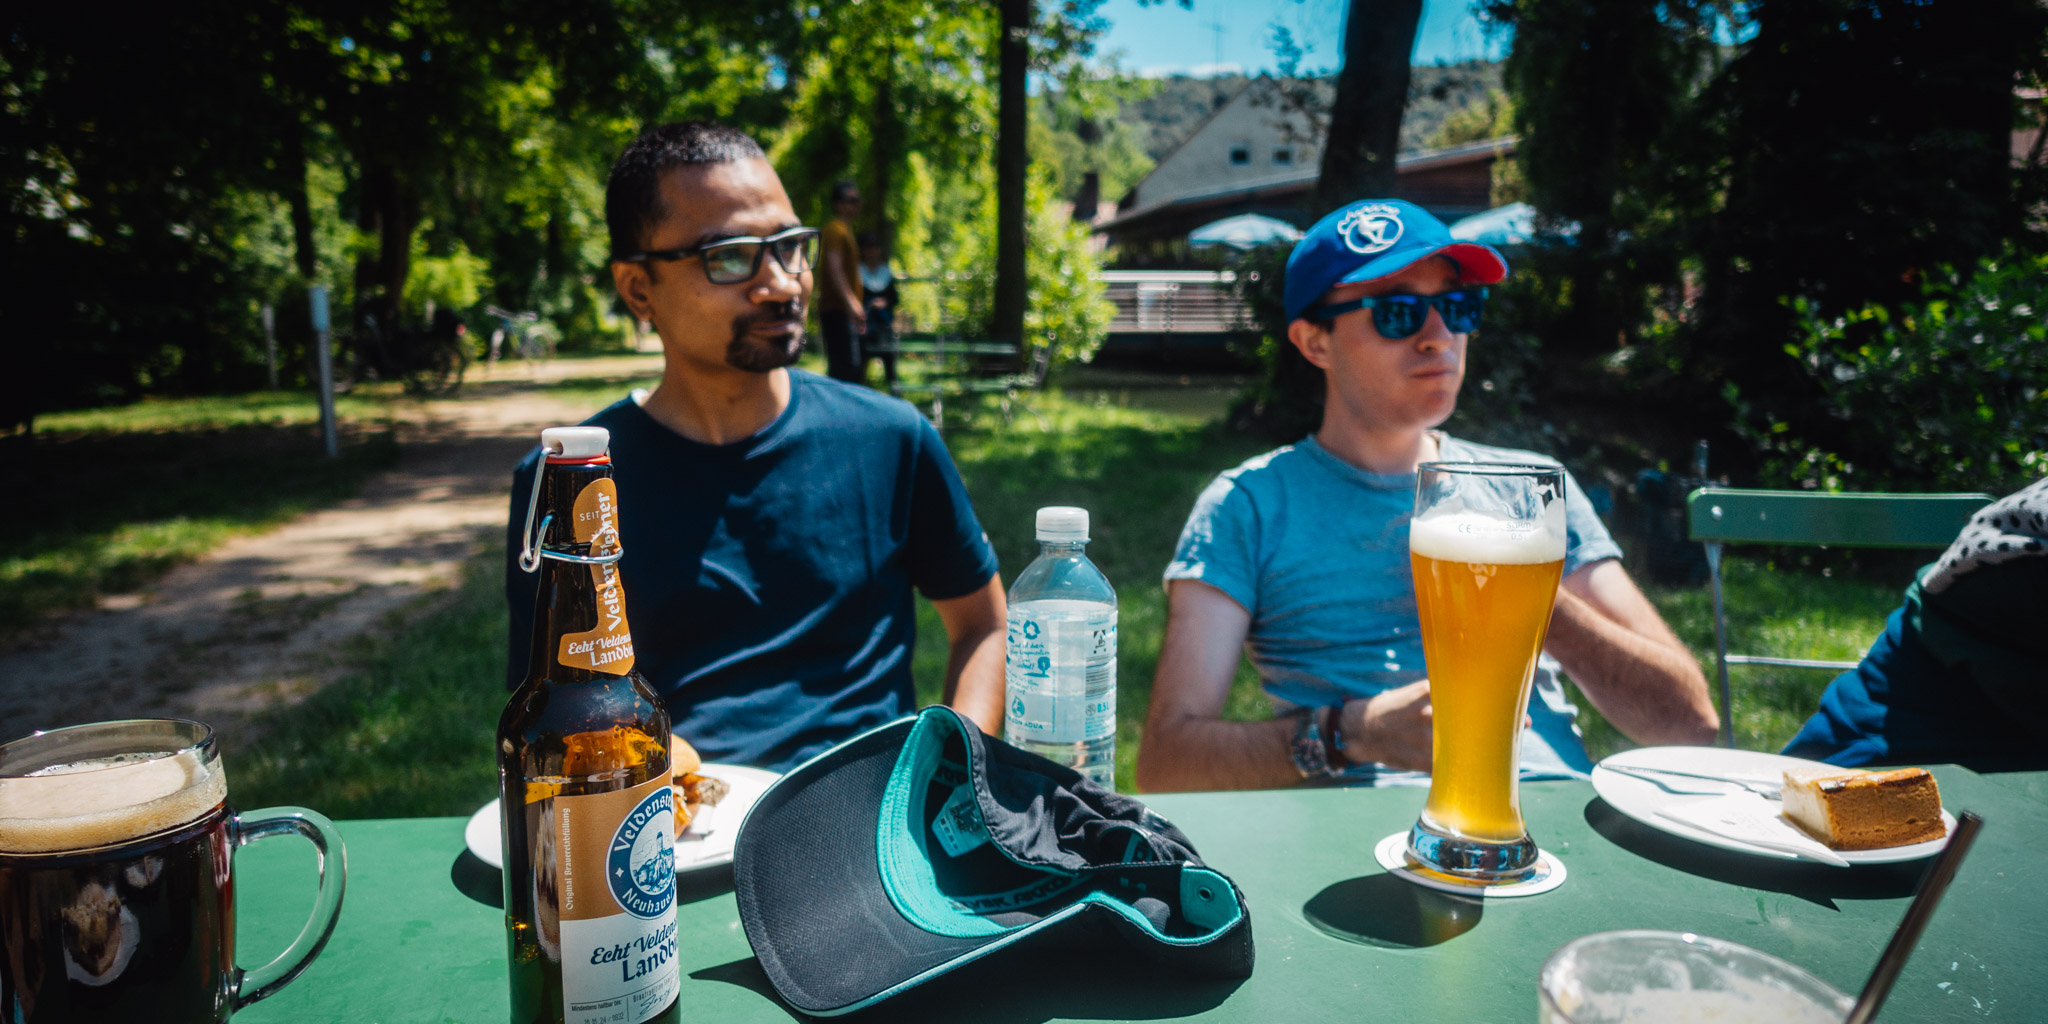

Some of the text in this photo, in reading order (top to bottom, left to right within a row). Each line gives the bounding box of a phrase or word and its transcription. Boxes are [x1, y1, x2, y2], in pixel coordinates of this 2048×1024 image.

[579, 510, 600, 521] SEIT
[568, 640, 595, 655] Echt
[565, 877, 575, 911] Original
[590, 942, 632, 965] Echt
